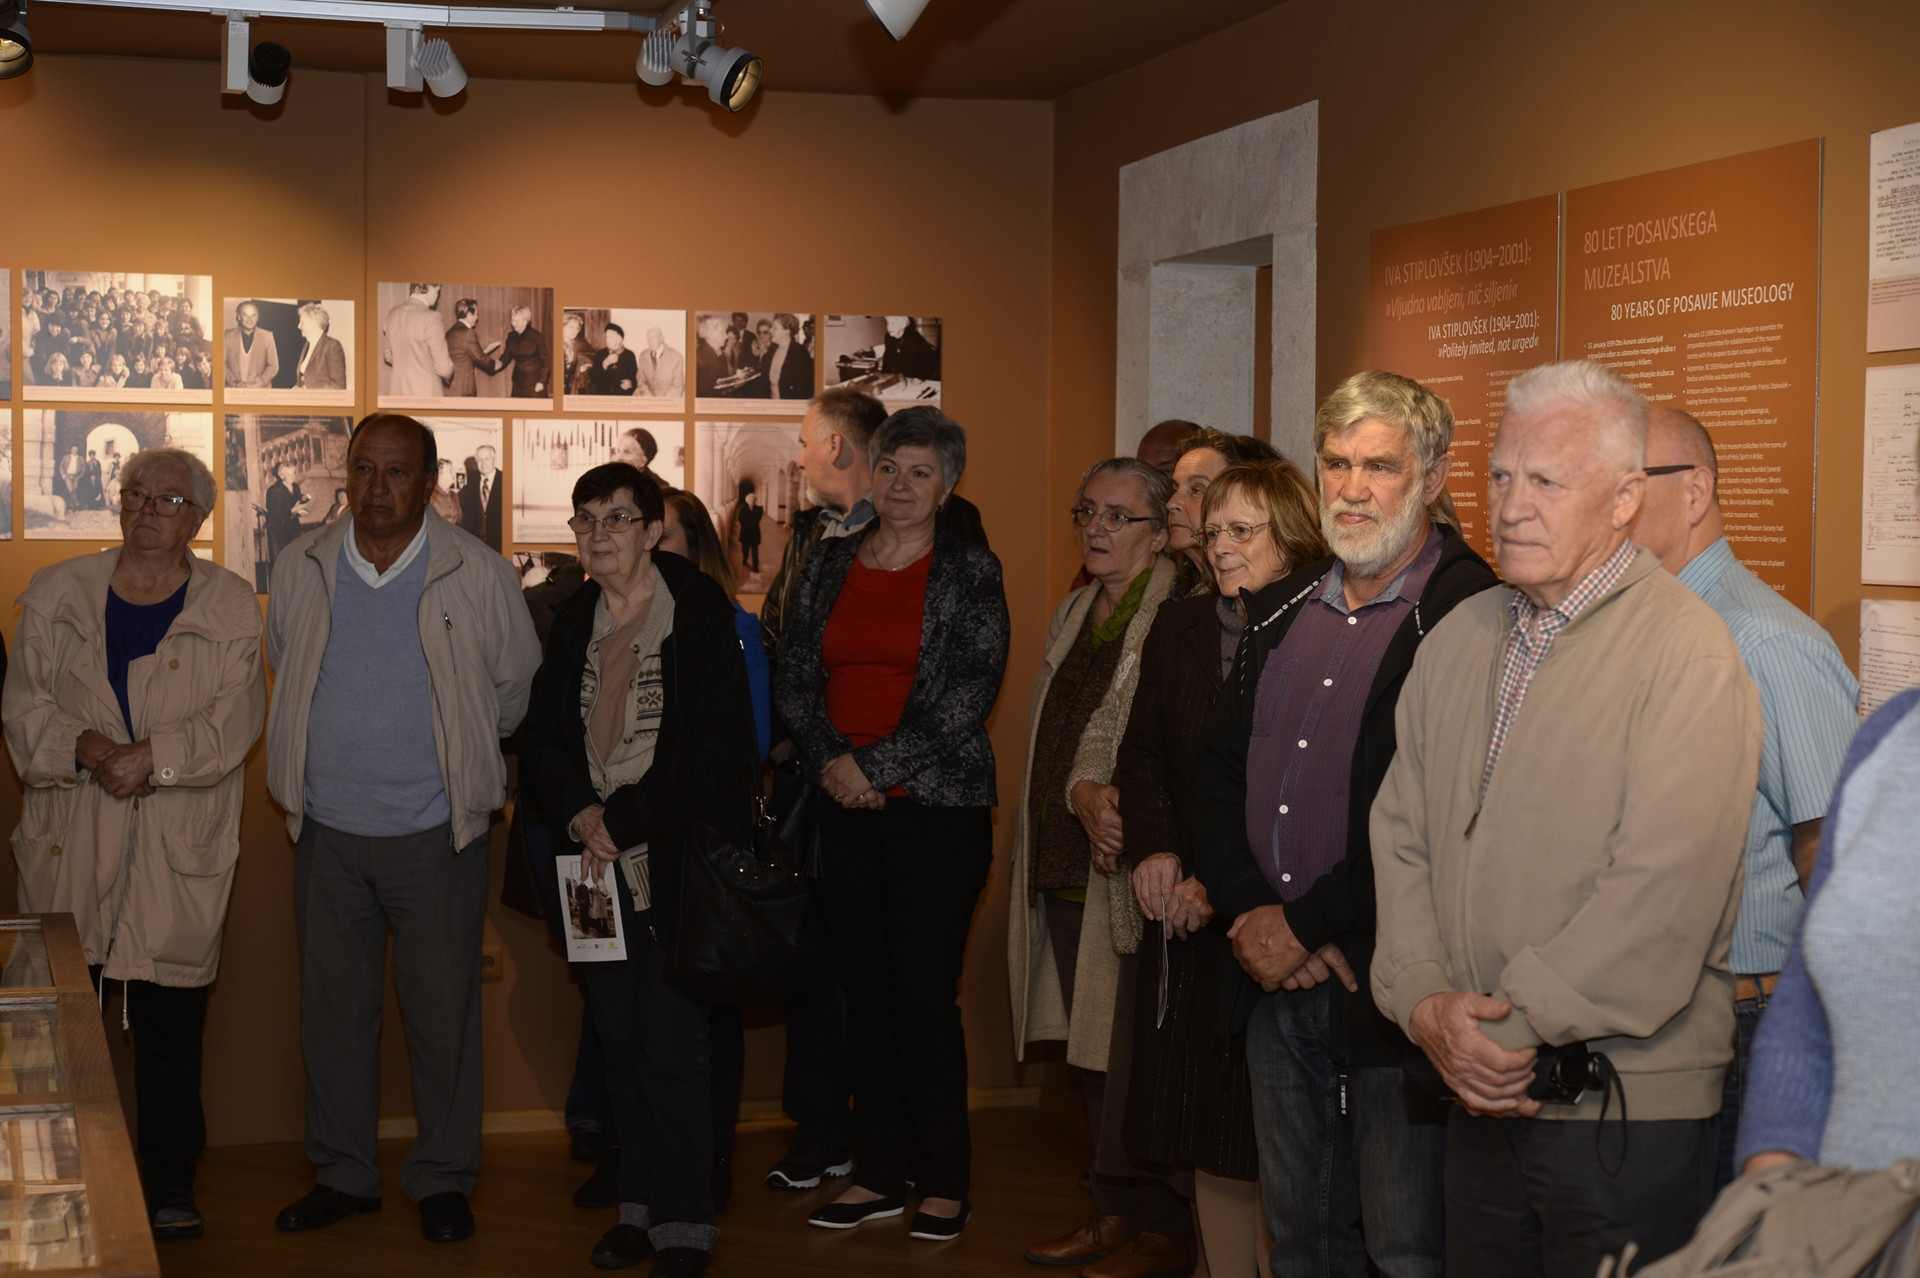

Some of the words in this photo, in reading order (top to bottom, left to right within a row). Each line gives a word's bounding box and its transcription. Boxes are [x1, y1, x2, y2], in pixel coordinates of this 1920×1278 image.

[1584, 230, 1599, 254] 80
[1601, 226, 1624, 251] LET
[1626, 209, 1718, 247] POSAVSKEGA
[1385, 265, 1402, 286] IVA
[1403, 249, 1463, 283] STIPLOVŠEK
[1465, 238, 1532, 276] (1904–2001):
[1584, 256, 1671, 291] MUZEALSTVA
[1385, 293, 1424, 321] »Vljudno
[1426, 286, 1465, 315] vabljeni,
[1467, 281, 1483, 305] nič
[1610, 304, 1623, 321] 80
[1624, 299, 1655, 319] YEARS
[1657, 297, 1671, 316] OF
[1673, 291, 1719, 314] POSAVJE
[1721, 282, 1795, 307] MUSEOLOGY
[1428, 325, 1441, 341] IVA
[1442, 315, 1488, 339] STIPLOVŠEK
[1489, 309, 1540, 335] (1904–2001):
[1469, 336, 1496, 356] invited,
[1497, 338, 1511, 352] not
